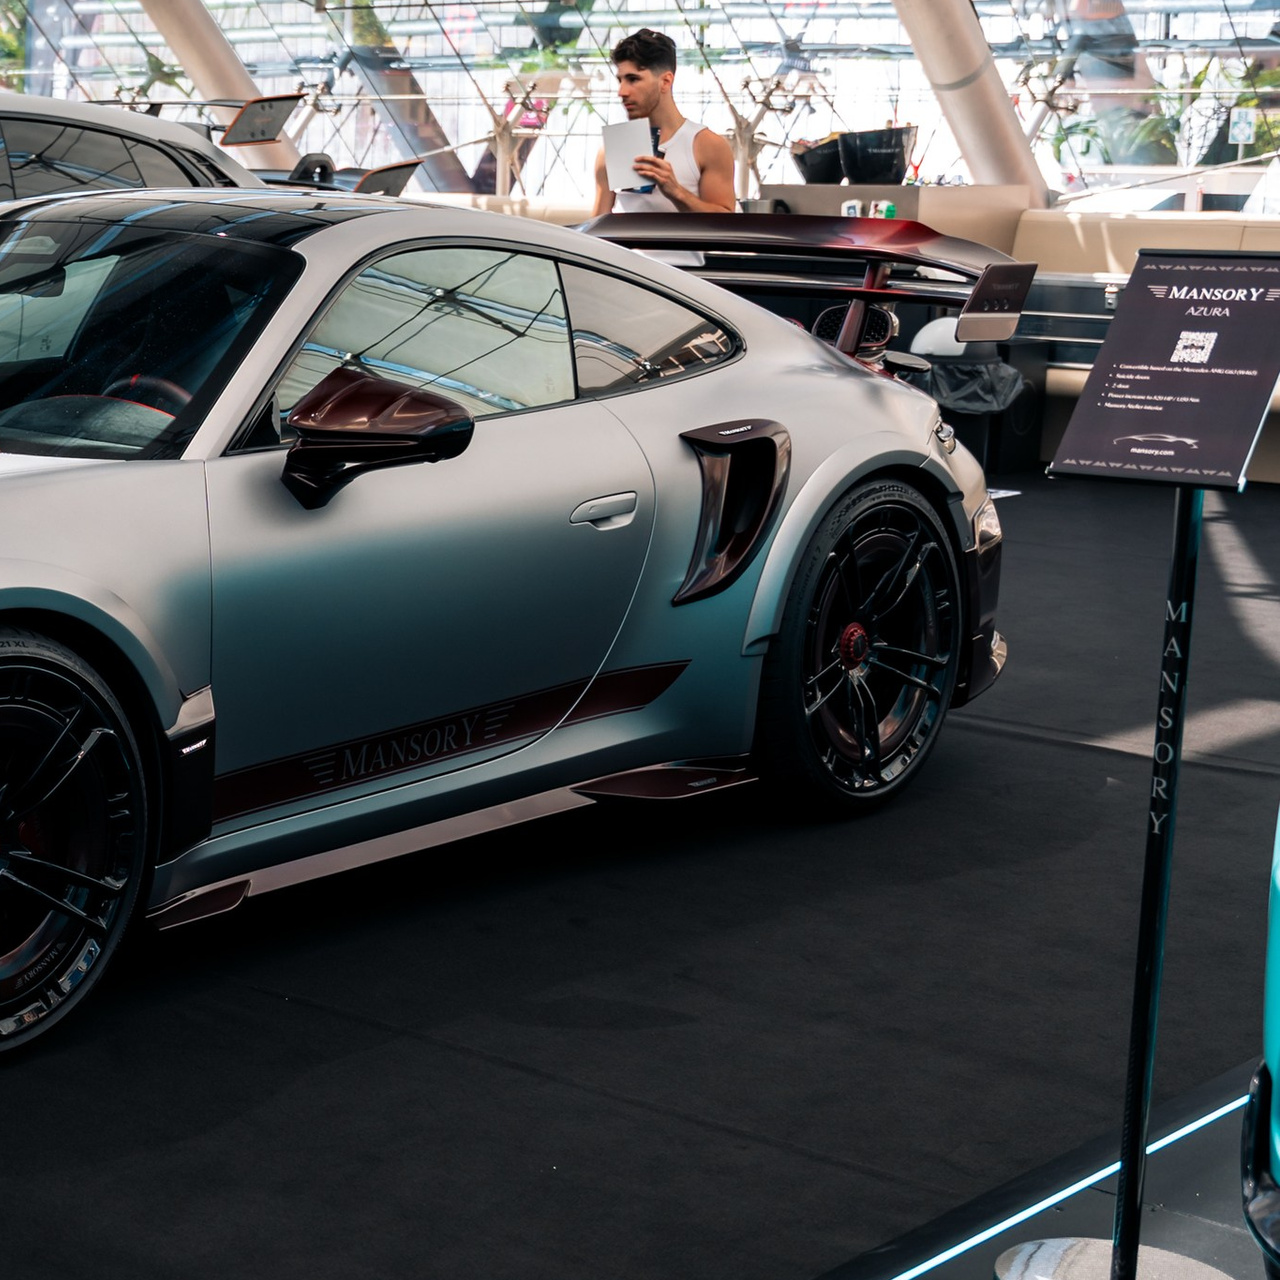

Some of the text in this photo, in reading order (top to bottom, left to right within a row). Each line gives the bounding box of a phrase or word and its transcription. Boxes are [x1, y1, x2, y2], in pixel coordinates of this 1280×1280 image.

[1167, 285, 1265, 302] MANSORY
[1184, 306, 1231, 318] AZURA
[1130, 446, 1175, 457] mansory.com
[13, 640, 29, 648] XL
[1149, 599, 1190, 836] MANSORY
[341, 714, 481, 780] MANSORY
